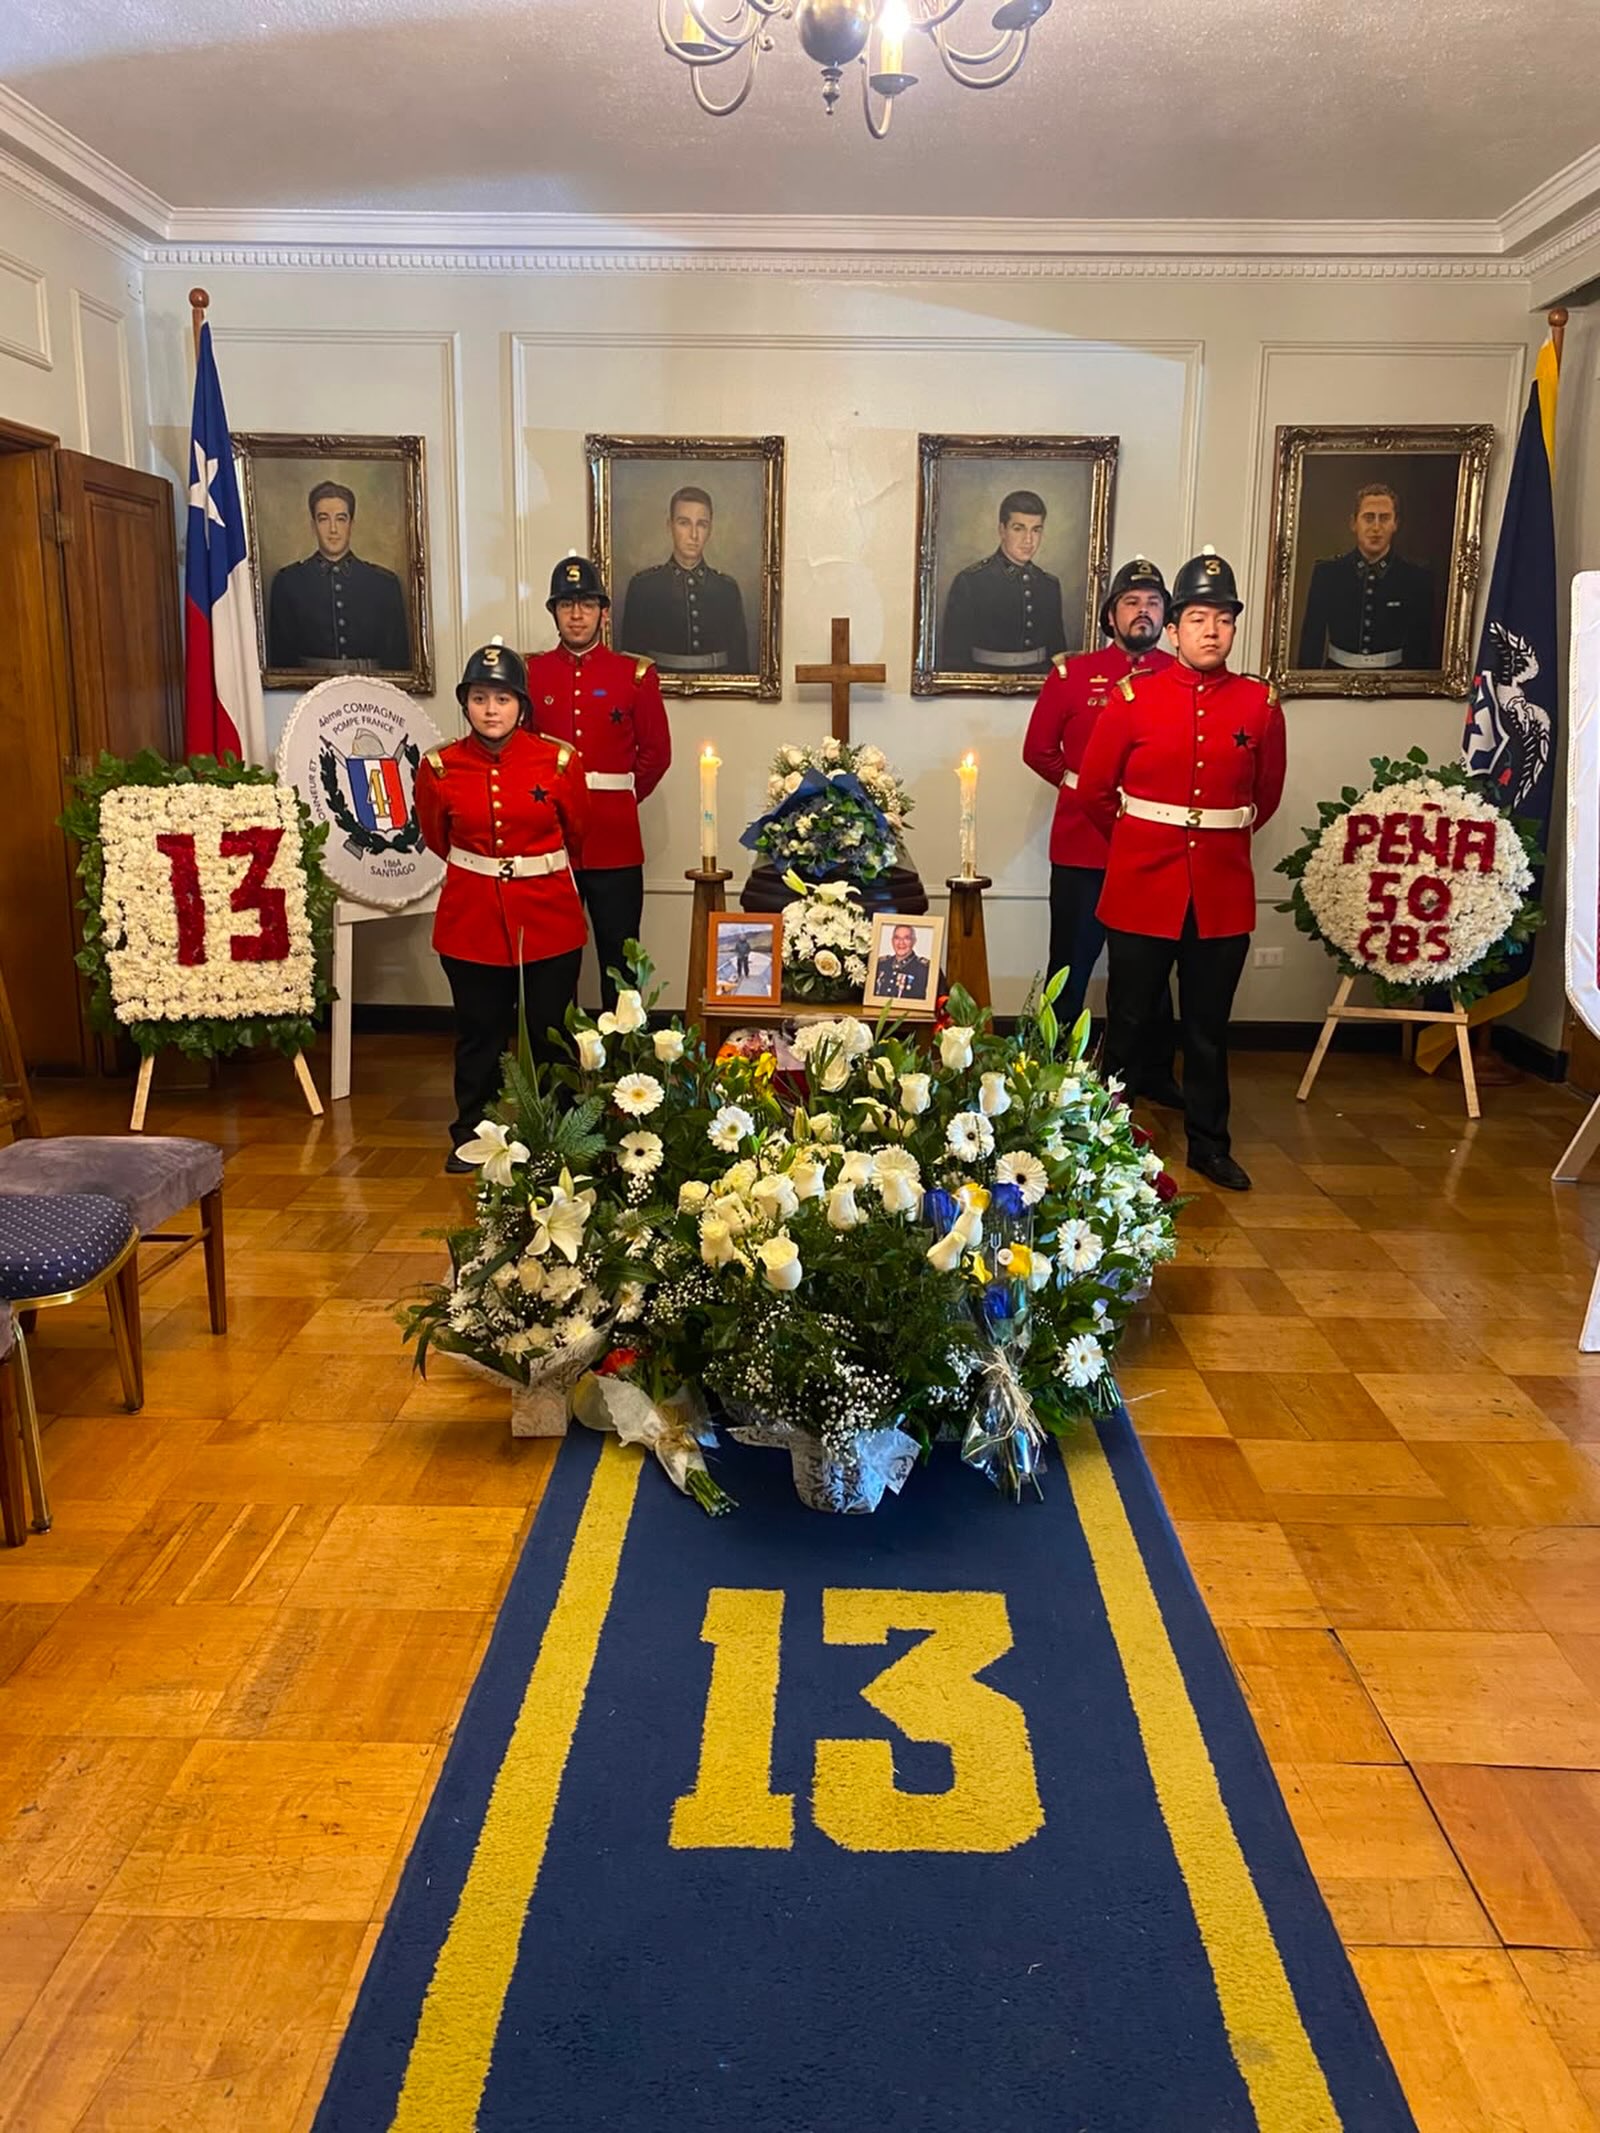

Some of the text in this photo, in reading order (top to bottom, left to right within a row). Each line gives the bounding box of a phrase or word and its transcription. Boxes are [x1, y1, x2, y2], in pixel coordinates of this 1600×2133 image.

[566, 565, 580, 581] 3
[1205, 560, 1221, 576] 3
[483, 649, 500, 666] 3
[332, 715, 395, 736] POMPE FRANCE
[342, 702, 406, 728] COMPAGNIE
[308, 759, 326, 821] ONNEUR ET
[1185, 810, 1203, 827] 3
[1342, 803, 1496, 873] PEÑA
[370, 862, 416, 878] SANTIAGO
[498, 859, 514, 879] 3
[156, 826, 291, 967] 13
[1367, 872, 1451, 922] 50
[1357, 925, 1451, 965] CBS
[668, 1587, 1046, 1853] 13
